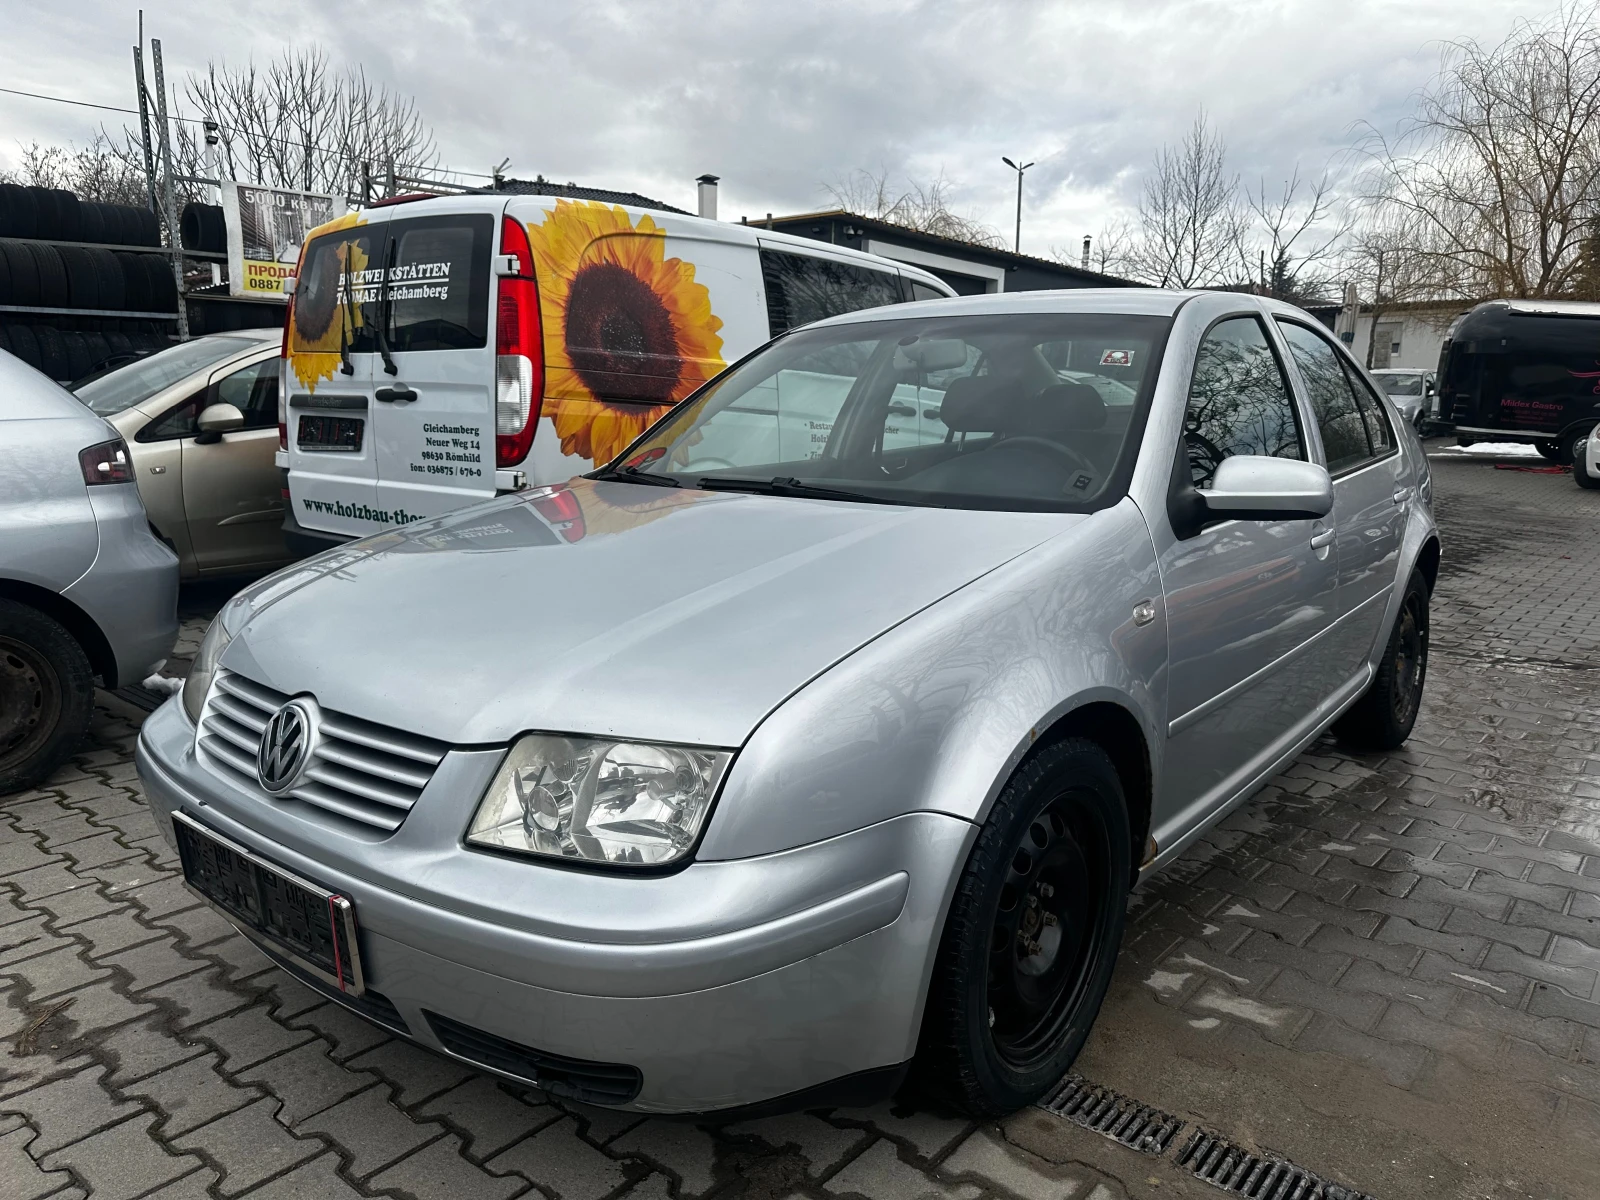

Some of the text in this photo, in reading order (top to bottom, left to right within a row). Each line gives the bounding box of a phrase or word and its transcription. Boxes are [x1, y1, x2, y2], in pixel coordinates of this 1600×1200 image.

[244, 190, 286, 208] 5000
[249, 278, 281, 290] 0887
[1500, 398, 1564, 411] Mildex Gastro
[423, 423, 480, 437] Gleichamberg
[425, 437, 480, 450] Neuer Weg 14
[421, 451, 481, 463] 98630 Römhild
[410, 463, 426, 473] fon:
[427, 464, 454, 475] 036875
[459, 466, 482, 477] 676-0
[302, 499, 426, 525] www.holzbau-tho
